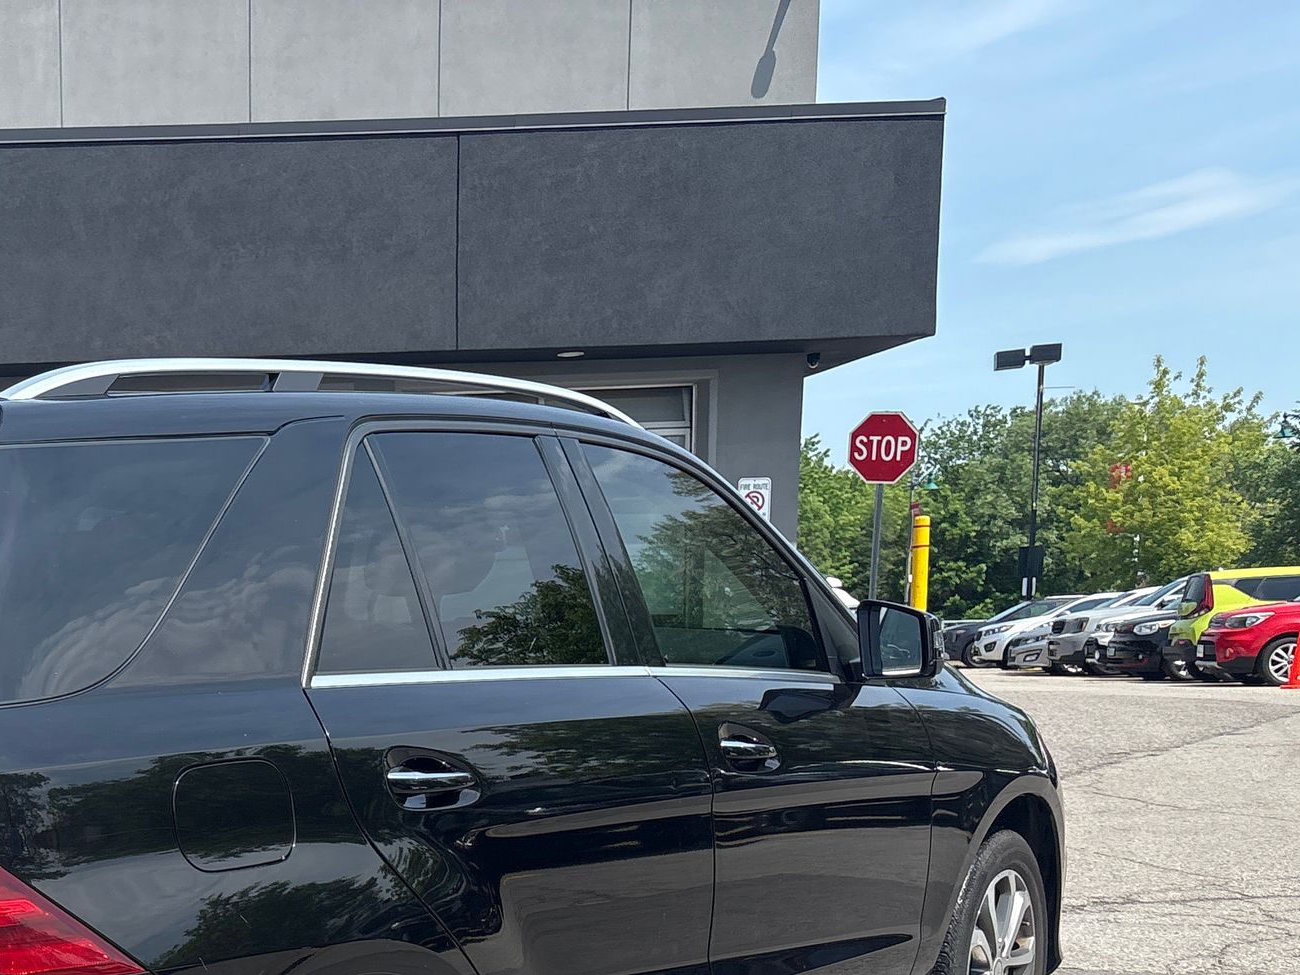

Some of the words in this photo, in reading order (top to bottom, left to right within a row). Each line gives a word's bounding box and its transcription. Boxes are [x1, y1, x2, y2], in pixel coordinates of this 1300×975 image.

[853, 435, 912, 462] STOP
[739, 483, 751, 491] FIRE
[752, 482, 770, 491] ROUTE
